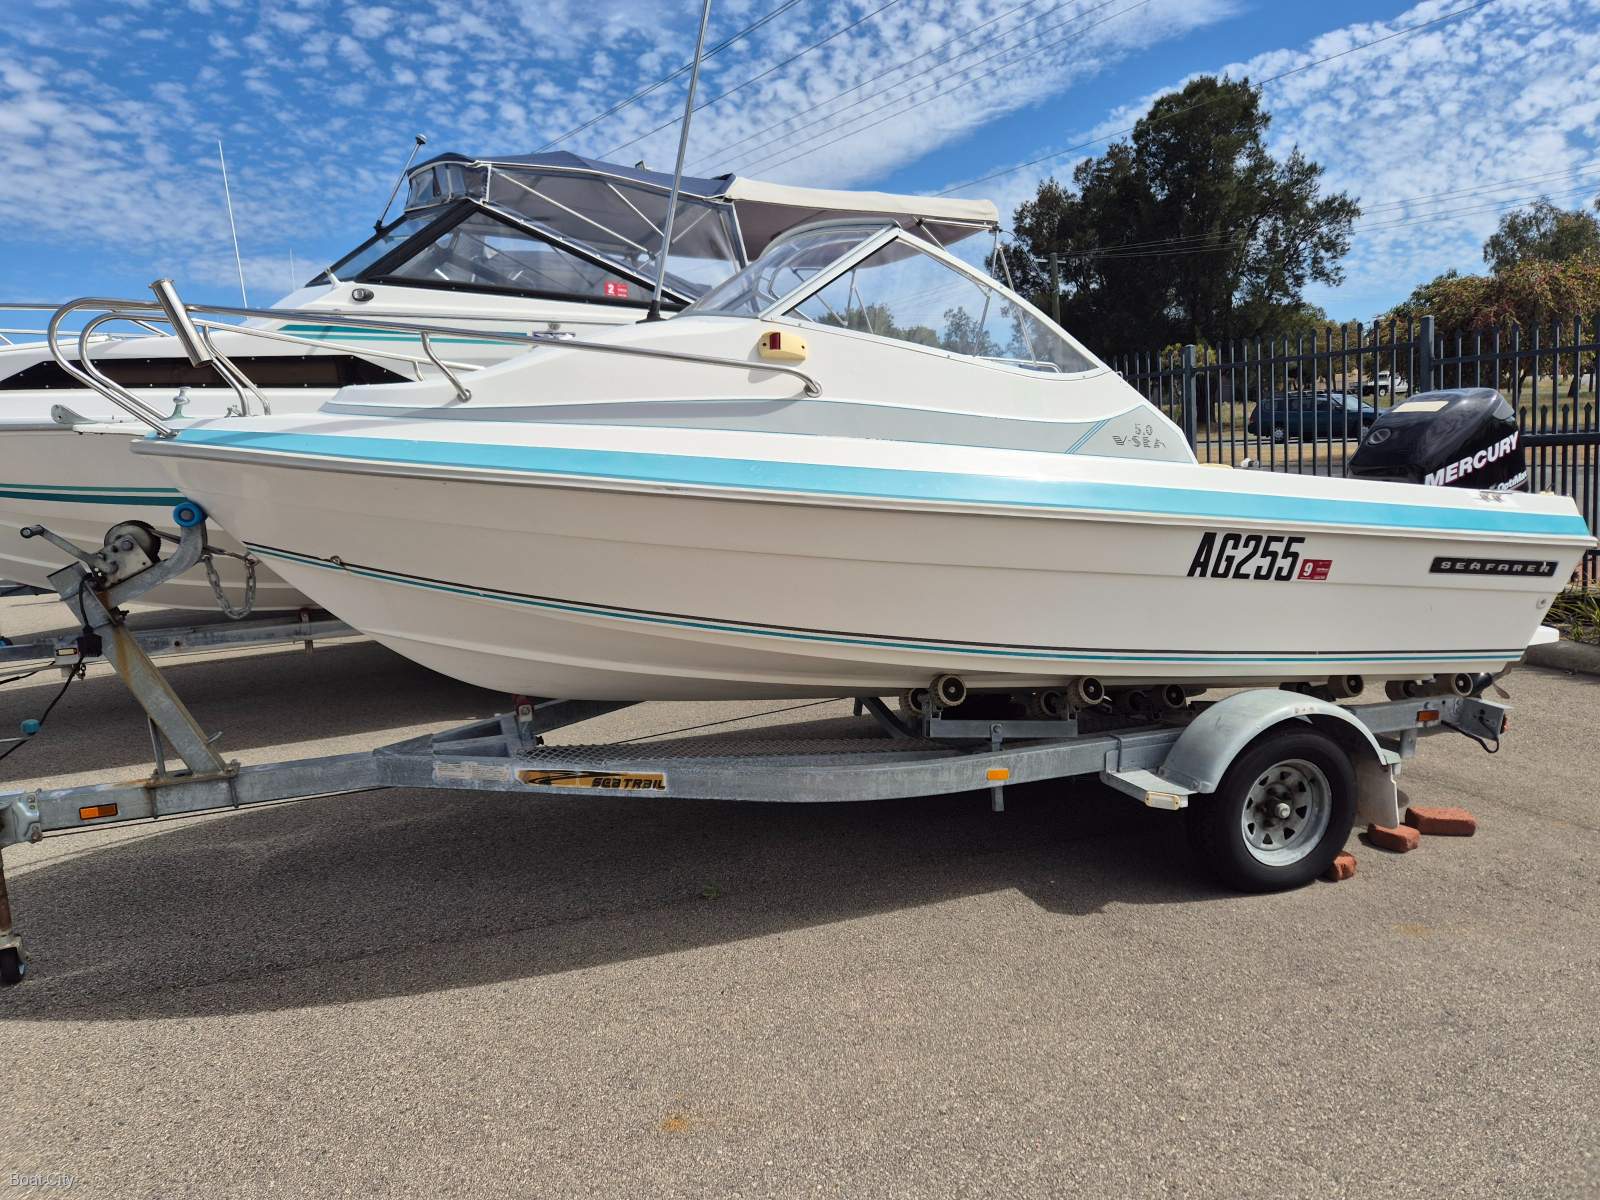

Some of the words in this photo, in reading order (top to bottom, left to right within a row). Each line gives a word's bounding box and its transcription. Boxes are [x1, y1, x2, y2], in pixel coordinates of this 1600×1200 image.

[608, 283, 615, 294] 2
[1424, 430, 1519, 486] MERCURY
[1187, 532, 1306, 581] AG255
[1303, 562, 1314, 577] 9
[1440, 560, 1551, 573] SEAFARER
